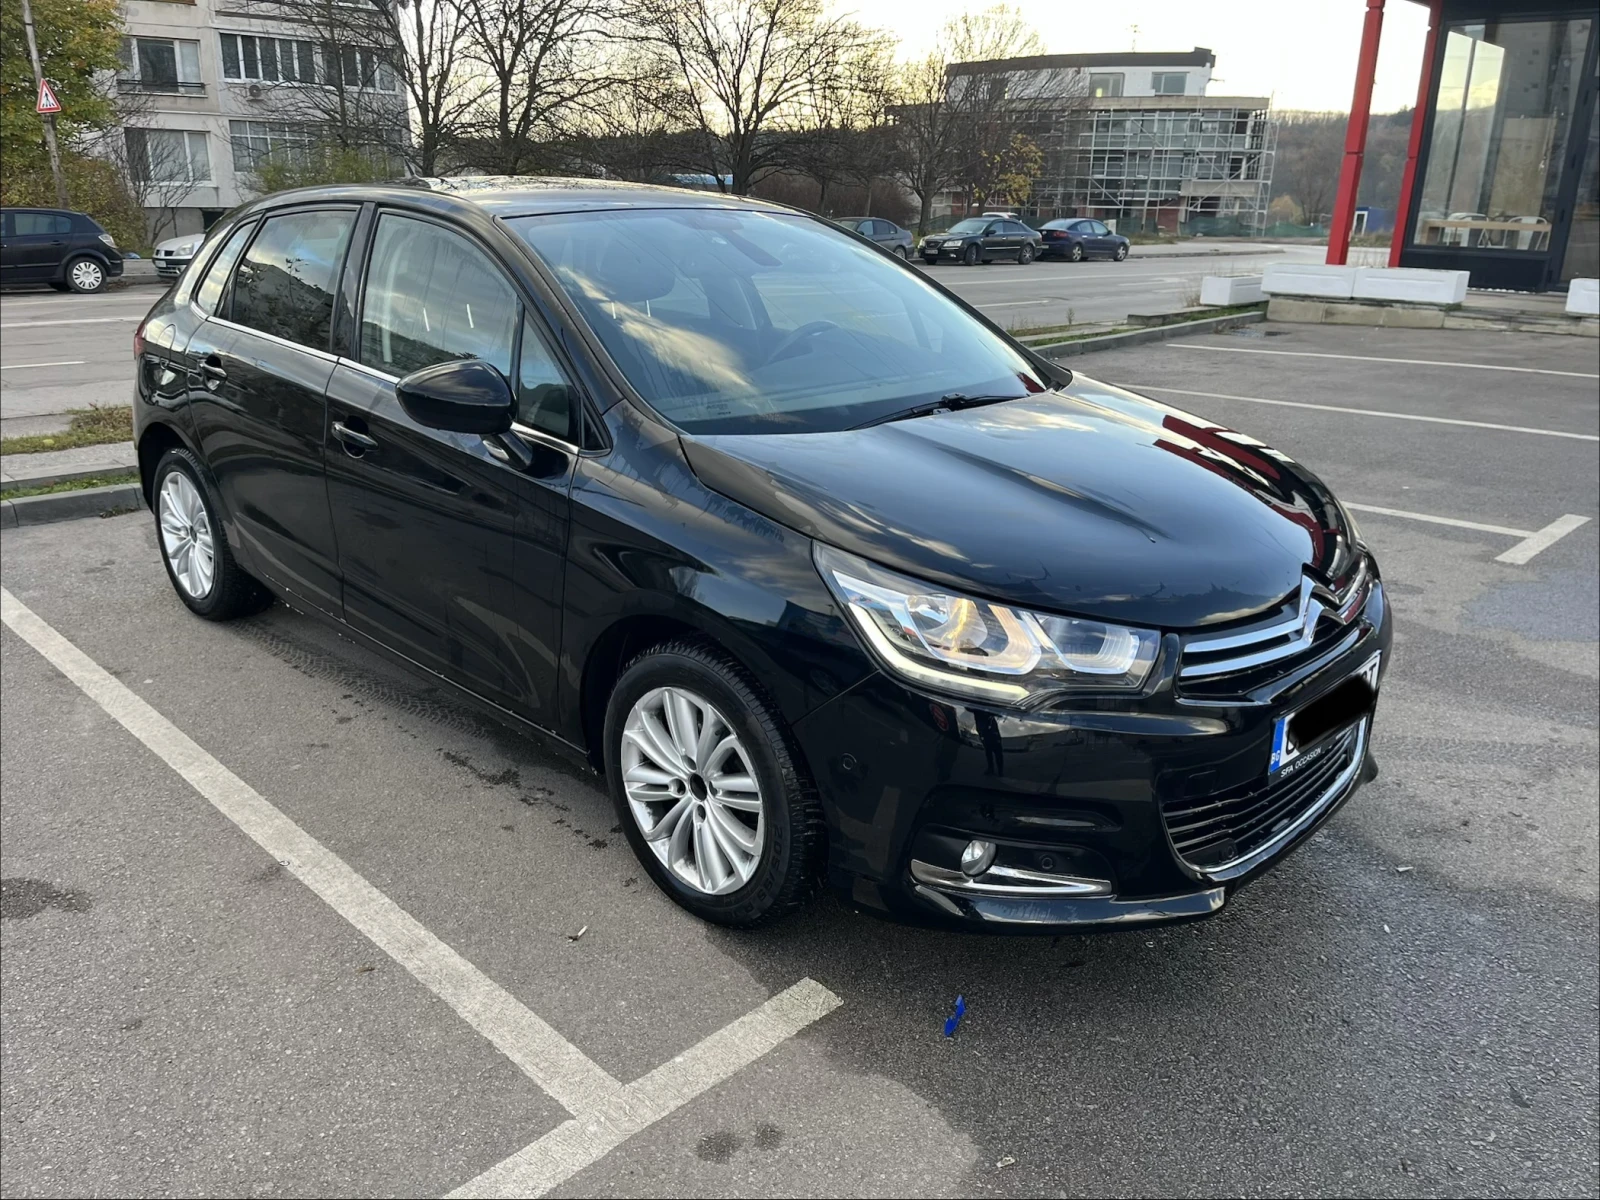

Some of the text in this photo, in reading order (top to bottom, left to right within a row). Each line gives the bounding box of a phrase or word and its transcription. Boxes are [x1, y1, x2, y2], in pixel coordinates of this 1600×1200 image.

[1270, 750, 1281, 765] BG
[1280, 746, 1322, 778] SFA OCCASION
